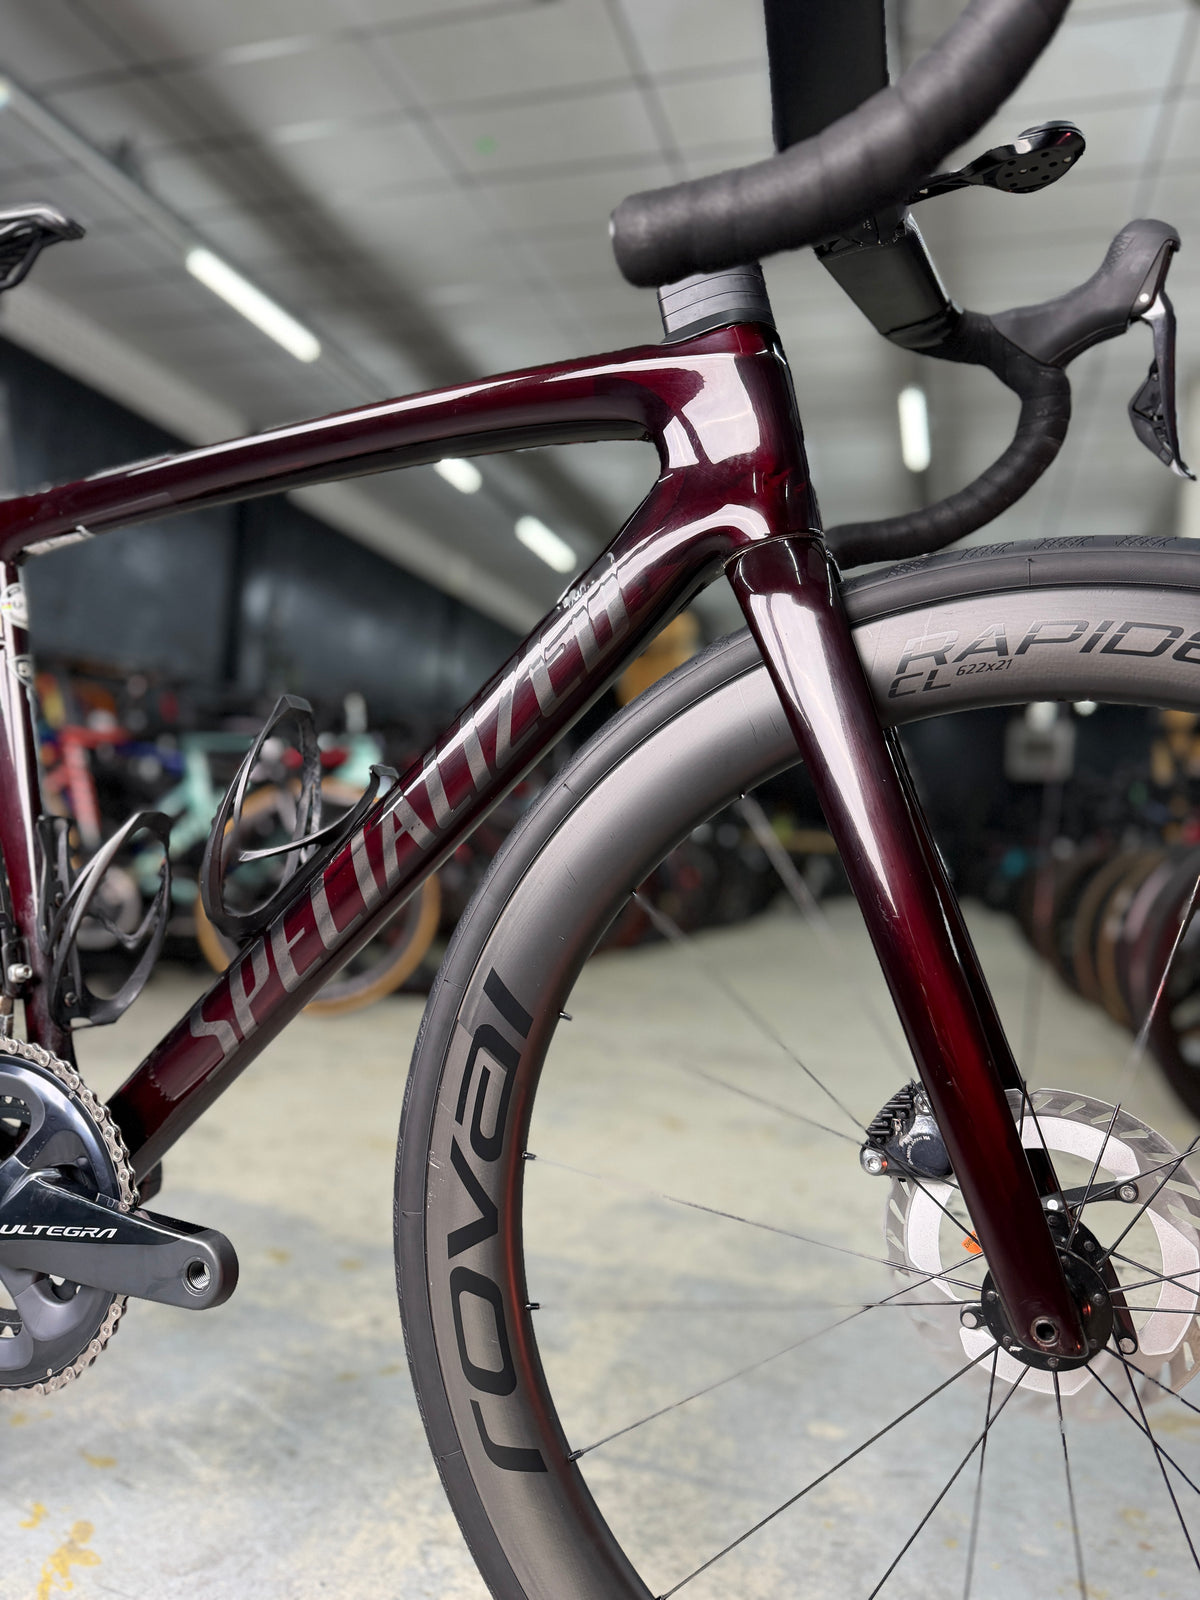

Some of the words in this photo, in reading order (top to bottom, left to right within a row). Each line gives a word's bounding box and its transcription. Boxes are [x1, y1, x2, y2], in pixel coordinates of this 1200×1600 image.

[888, 669, 951, 698] CL
[956, 659, 1013, 676] 622x21
[190, 571, 631, 1083] SPECIALIZED
[0, 1224, 118, 1238] ULTEGRA
[447, 968, 548, 1472] roval
